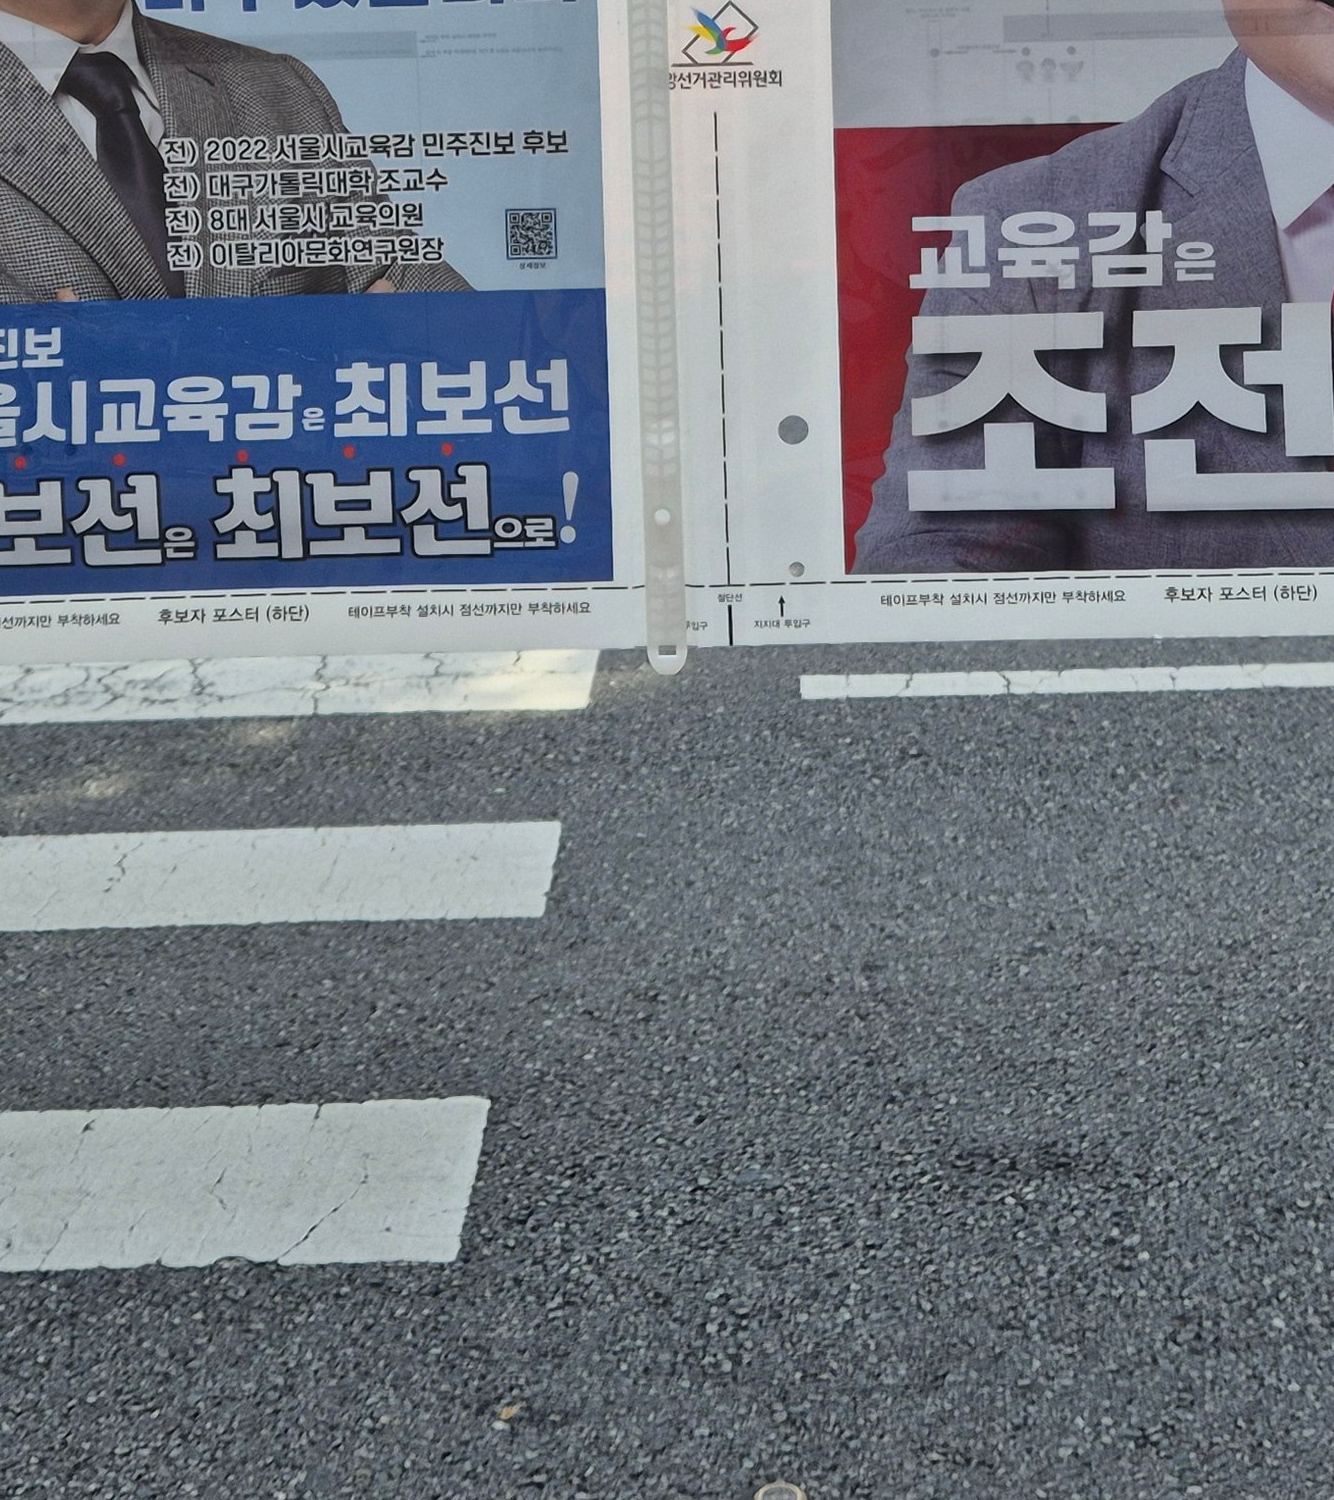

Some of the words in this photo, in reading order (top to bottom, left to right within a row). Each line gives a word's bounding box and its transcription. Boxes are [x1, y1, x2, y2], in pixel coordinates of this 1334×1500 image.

[668, 69, 783, 90] 앙선거관리위원회
[165, 140, 197, 164] 전)
[207, 140, 266, 161] 2022
[275, 134, 415, 161] 서울시교육감
[422, 132, 515, 157] 민주진보
[523, 130, 568, 154] 후보
[166, 174, 199, 199] 전)
[209, 170, 371, 198] 대구가톨릭대학
[379, 168, 448, 193] 조교수
[168, 208, 200, 234] 전)
[210, 207, 248, 232] 8대
[254, 204, 326, 230] 서울시
[332, 203, 424, 228] 교육의원
[170, 243, 203, 268] 전)
[212, 237, 444, 266] 이탈리아문화연구원장
[909, 210, 1216, 289] 교육감은
[334, 359, 570, 437] 최보선
[215, 463, 579, 560] 최보선으로!
[1165, 587, 1212, 602] 후보자
[1219, 586, 1266, 601] 포스터
[1274, 585, 1317, 601] (하단)
[158, 609, 206, 625] 후보자
[213, 607, 258, 622] 포스터
[267, 605, 309, 622] (하단)
